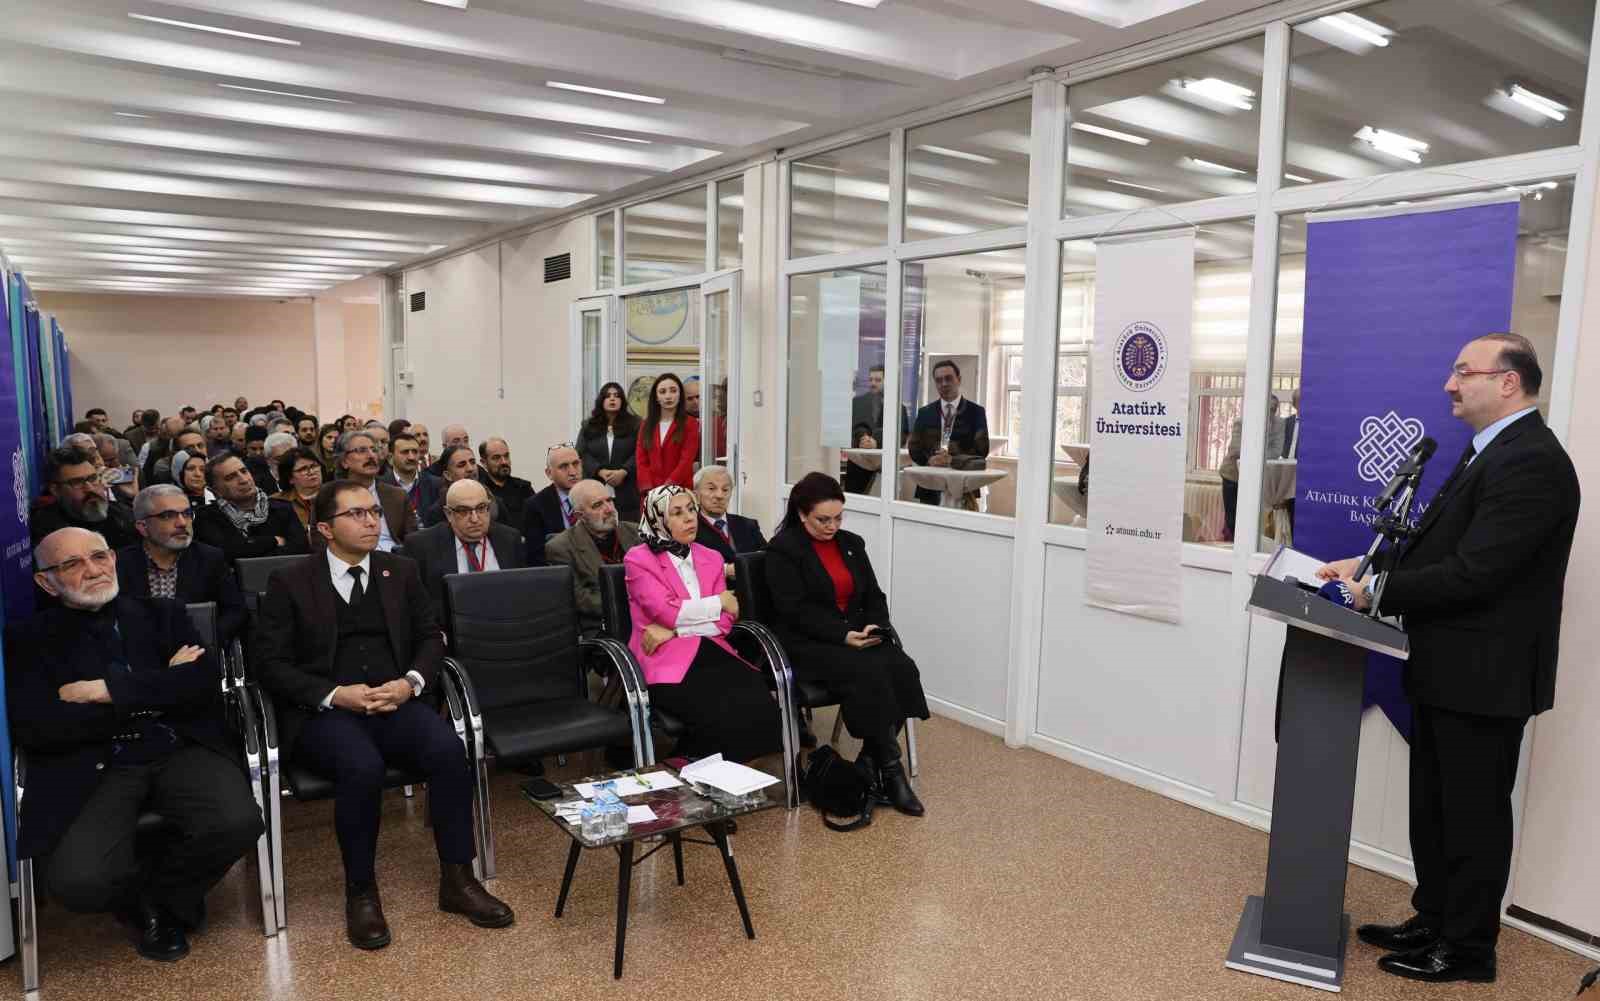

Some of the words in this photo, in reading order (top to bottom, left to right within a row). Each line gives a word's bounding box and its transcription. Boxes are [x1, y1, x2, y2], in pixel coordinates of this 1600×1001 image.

[1111, 401, 1167, 416] Atatürk
[1096, 417, 1182, 437] Üniversitesi
[1305, 489, 1360, 507] ATATÜRK
